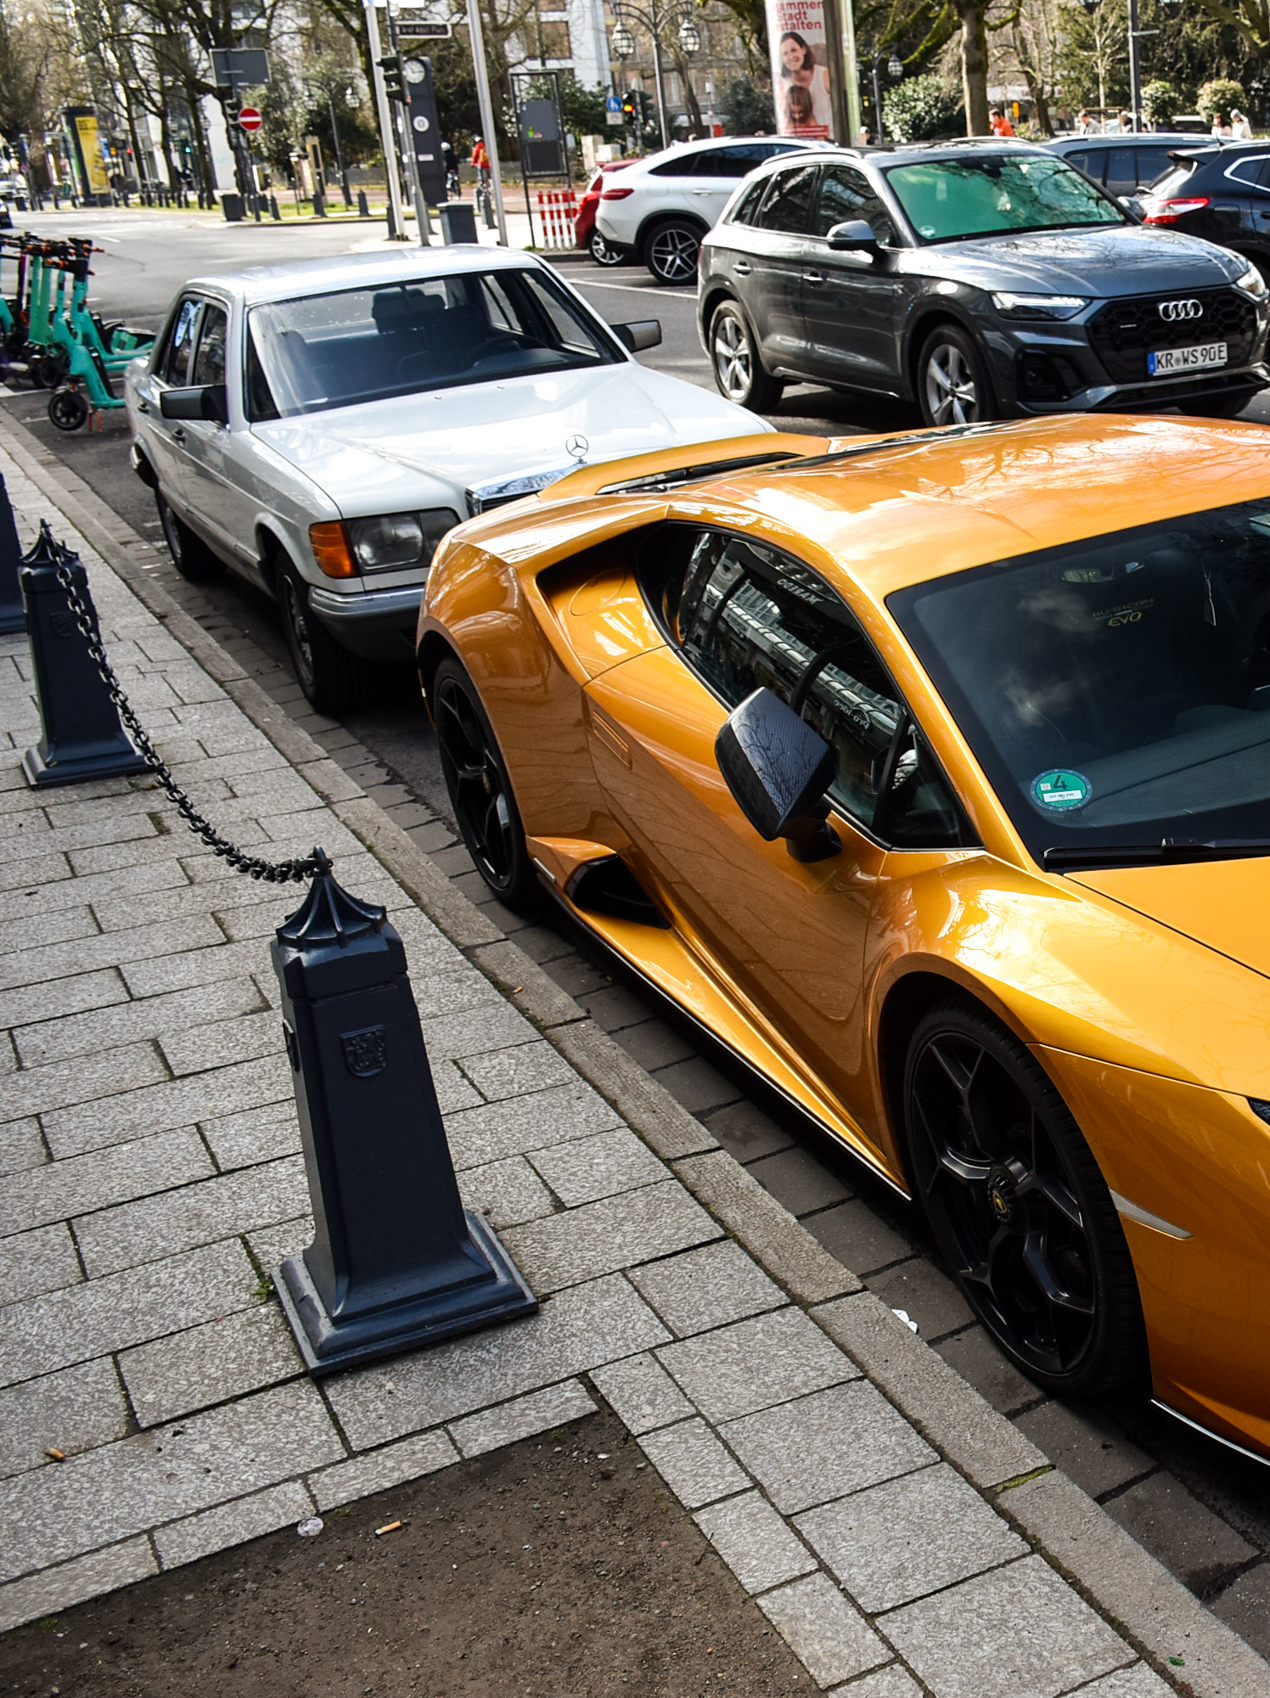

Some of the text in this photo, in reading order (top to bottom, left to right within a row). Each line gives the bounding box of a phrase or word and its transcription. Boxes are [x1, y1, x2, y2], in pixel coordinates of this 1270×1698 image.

[1156, 352, 1175, 370] KR
[1181, 348, 1199, 366] WS
[1107, 611, 1142, 627] EVO
[1053, 774, 1068, 790] 4
